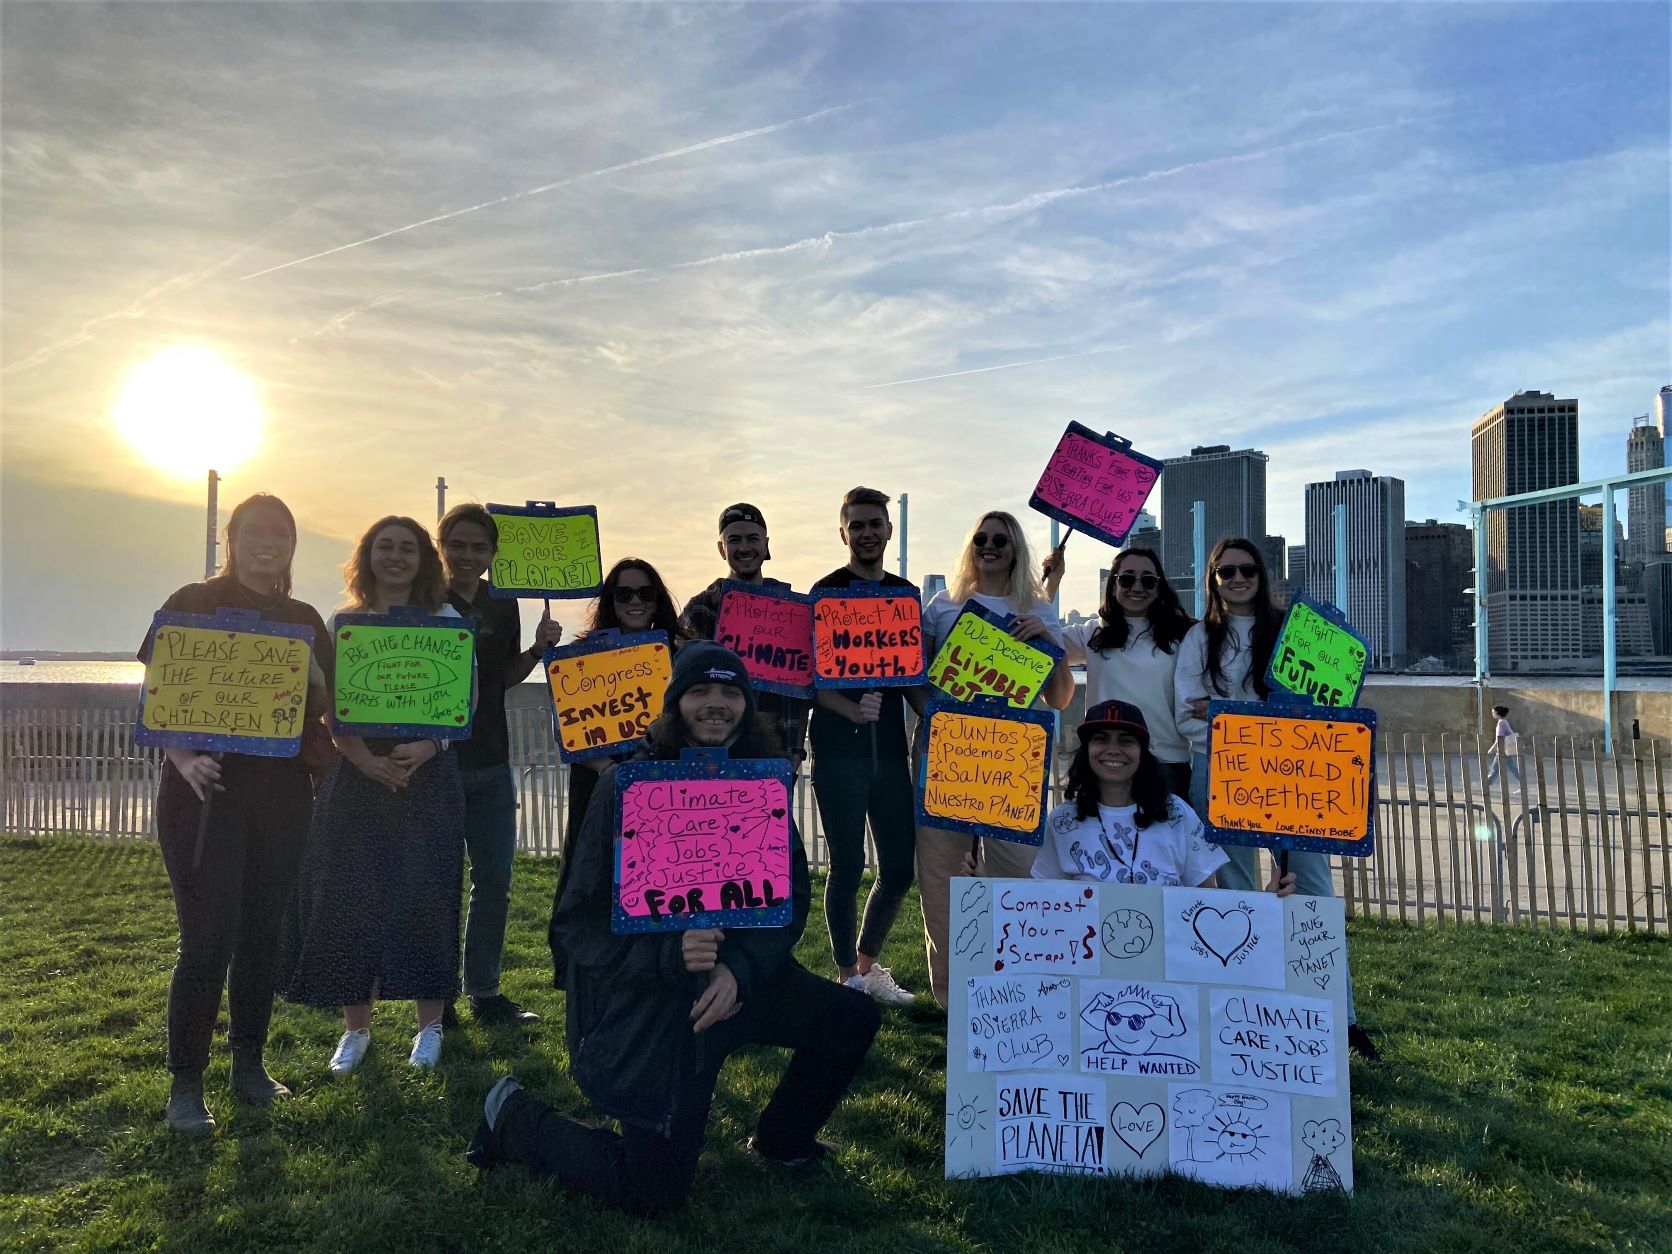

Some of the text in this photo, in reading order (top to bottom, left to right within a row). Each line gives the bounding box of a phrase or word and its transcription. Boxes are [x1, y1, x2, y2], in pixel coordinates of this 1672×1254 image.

[1067, 440, 1104, 467] THANKS
[499, 521, 568, 544] SAVE
[892, 604, 918, 622] ALL
[754, 625, 788, 639] OUR
[964, 620, 988, 645] We
[1294, 630, 1311, 653] FOR
[168, 632, 297, 664] PLEASE SAVE
[344, 634, 463, 667] BE THE CHANGE
[984, 654, 994, 664] A
[160, 664, 198, 682] THE
[562, 662, 652, 697] Congress
[180, 690, 258, 704] OF OUR
[1224, 720, 1354, 752] LET'S SAVE
[1215, 750, 1341, 781] THE WORLD
[648, 785, 754, 810] Climate
[668, 814, 720, 836] Care
[666, 840, 720, 863] Jobs
[654, 862, 754, 888] Justice
[644, 879, 784, 922] FOR ALL
[1000, 890, 1086, 918] Compost
[1018, 920, 1065, 938] Your
[972, 981, 1026, 1009] THANKS
[1284, 1036, 1328, 1057] JOBS
[1088, 1056, 1196, 1076] HELP WANTED
[1230, 1054, 1323, 1085] JUSTICE
[1000, 1088, 1096, 1121] SAVE THE
[1119, 1116, 1154, 1132] LOVE
[1002, 1121, 1104, 1172] PLANETA!
